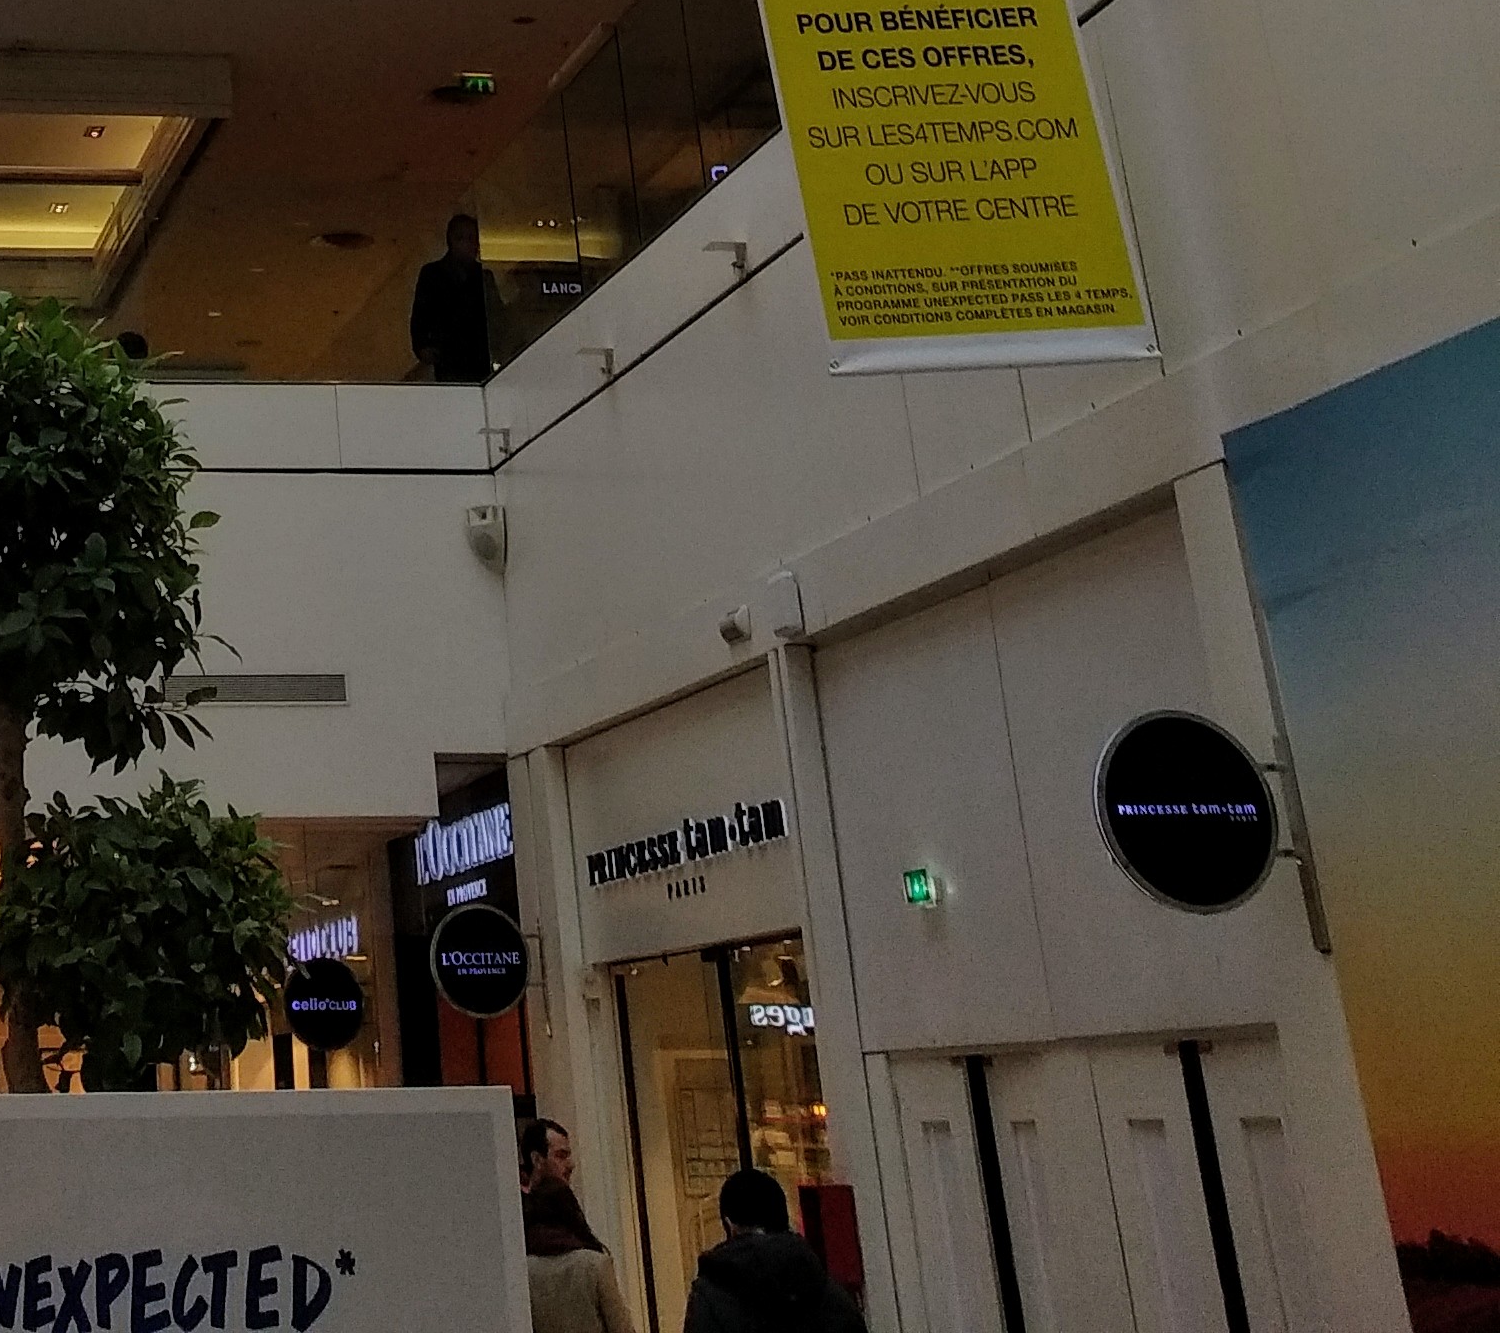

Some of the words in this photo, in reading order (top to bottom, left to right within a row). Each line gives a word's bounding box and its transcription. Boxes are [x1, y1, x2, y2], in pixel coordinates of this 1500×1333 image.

[796, 10, 873, 34] POUR
[879, 4, 1038, 32] BÉNÉFICIER
[817, 50, 854, 71] DE
[862, 47, 916, 68] CES
[923, 44, 1035, 68] OFFRES,
[832, 81, 1036, 109] INSCRIVEZ-VOUS
[808, 126, 861, 149] SUR
[869, 118, 1079, 146] LES4TEMPS.COM
[865, 163, 903, 185] OU
[911, 160, 965, 183] SUR
[971, 157, 1038, 181] L'APP
[843, 203, 880, 226] DE
[883, 199, 971, 224] VOTRE
[976, 194, 1078, 220] CENTRE
[932, 281, 958, 292] SUR
[1059, 275, 1077, 286] DU
[837, 298, 920, 311] PROGRAMME
[924, 293, 1009, 308] UNEXPECTED
[1012, 292, 1044, 303] PASS
[1047, 290, 1071, 301] LES
[839, 315, 870, 327] VOIR
[874, 312, 952, 325] CONDITIONS
[1036, 306, 1053, 317] EN
[1117, 804, 1188, 815] PRINCESSE
[587, 830, 682, 886] PRINCESSE
[442, 951, 521, 966] L'OCCITANE
